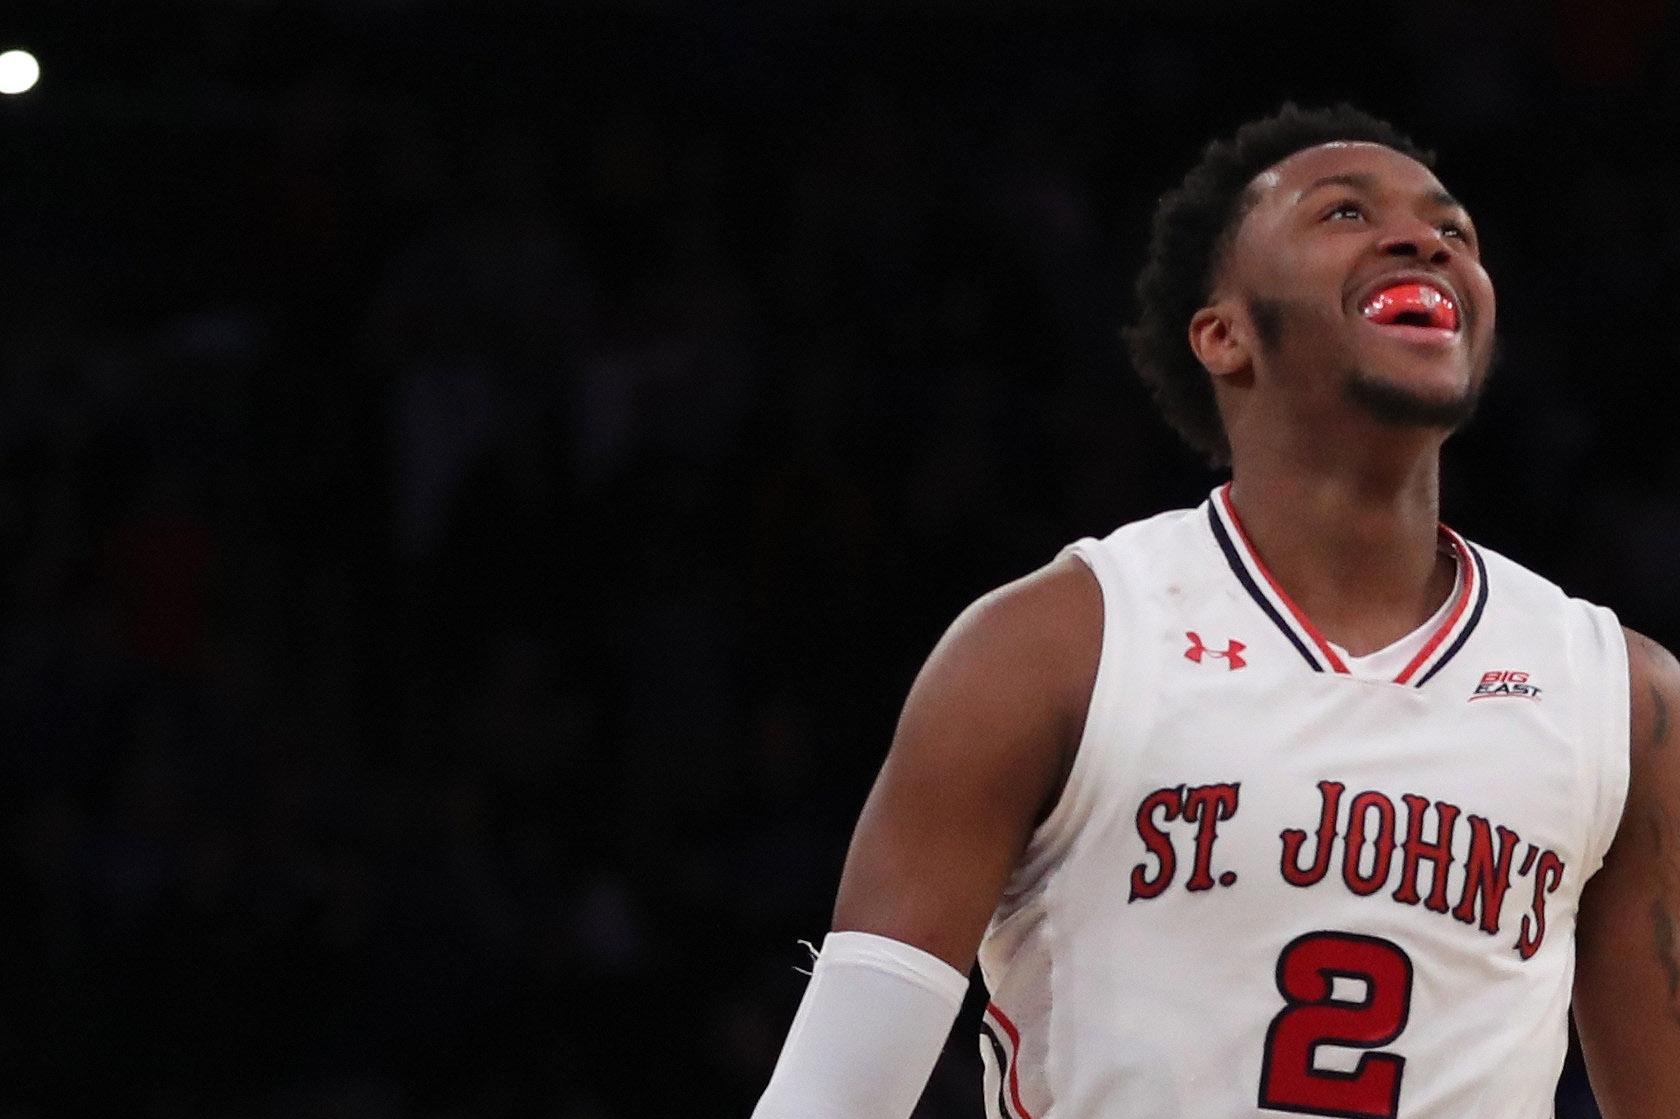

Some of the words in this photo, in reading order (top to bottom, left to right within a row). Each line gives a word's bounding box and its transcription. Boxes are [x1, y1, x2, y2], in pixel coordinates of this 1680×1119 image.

[1481, 671, 1530, 683] BIG
[1474, 683, 1542, 697] EAST
[1128, 782, 1241, 904] ST.
[1279, 780, 1566, 960] JOHN'S
